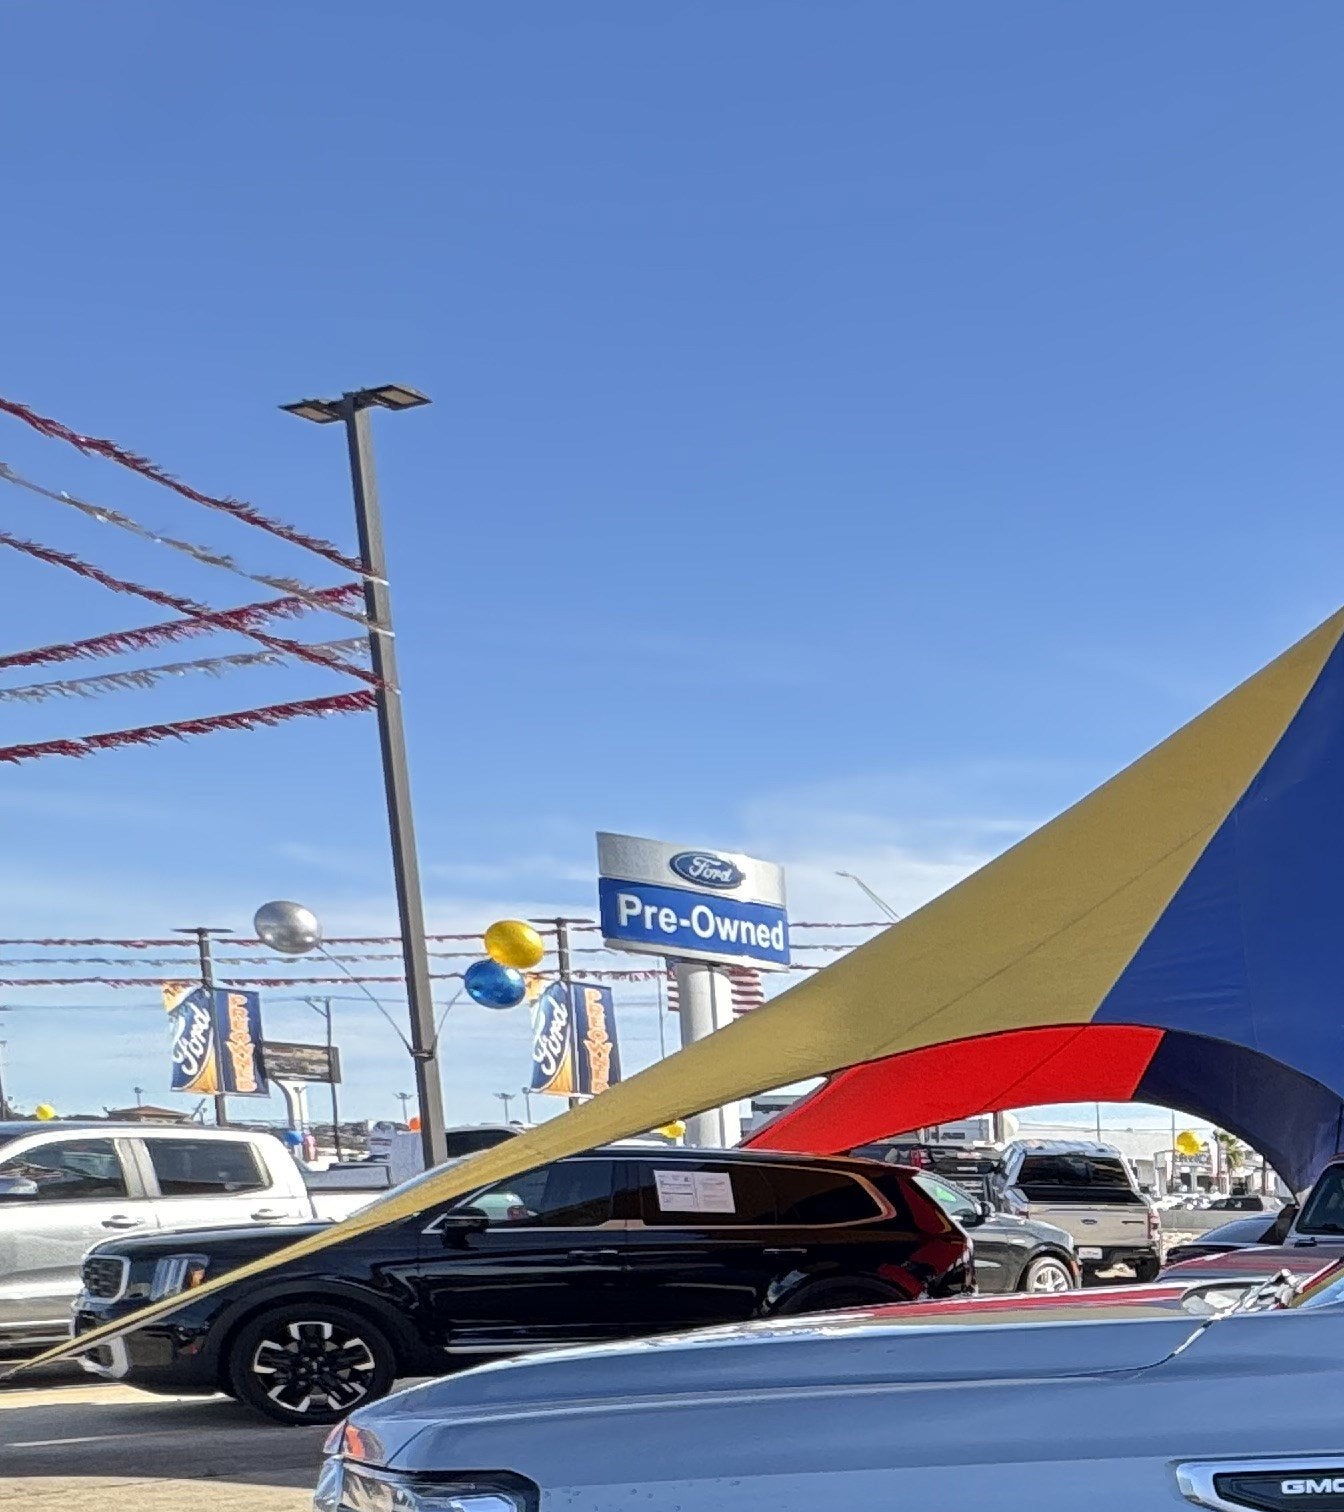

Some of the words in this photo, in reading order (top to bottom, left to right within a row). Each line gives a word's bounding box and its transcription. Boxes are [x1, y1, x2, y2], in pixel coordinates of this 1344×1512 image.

[688, 856, 733, 882] Ford
[616, 892, 785, 952] Pre-Owned
[171, 1001, 211, 1076] Ford
[532, 995, 568, 1076] Ford
